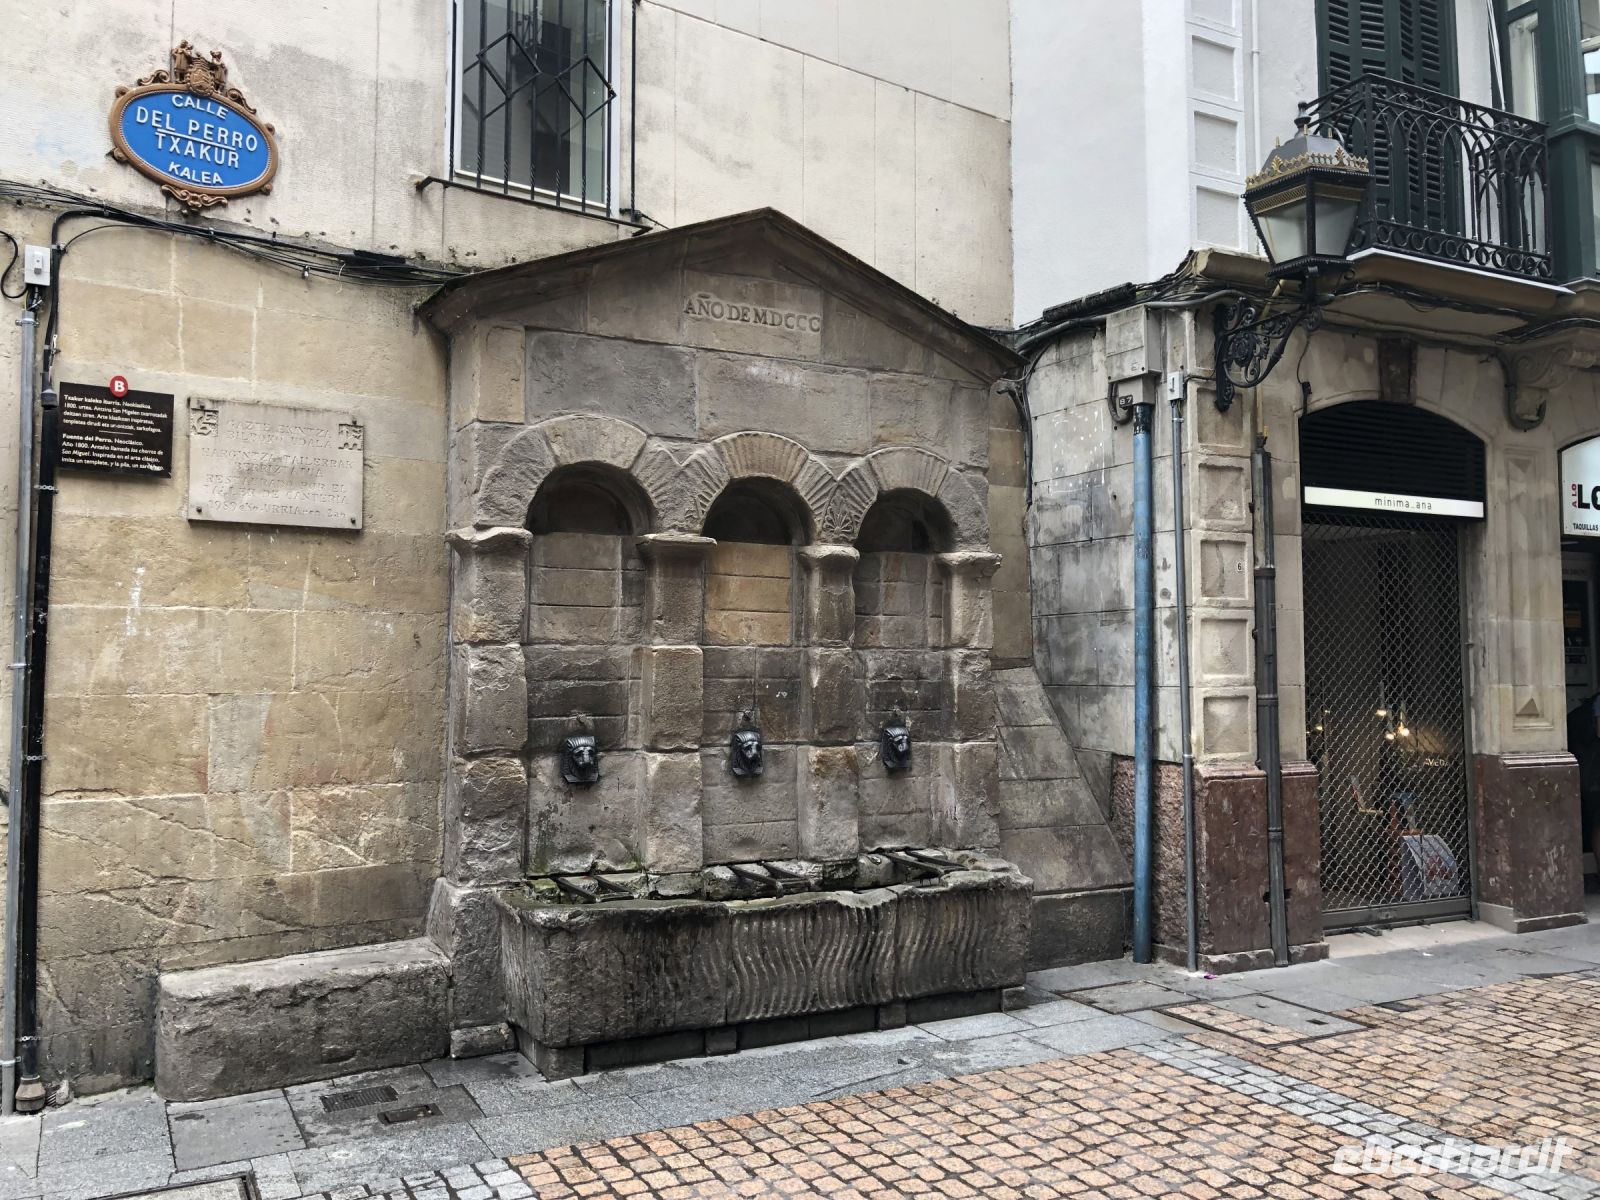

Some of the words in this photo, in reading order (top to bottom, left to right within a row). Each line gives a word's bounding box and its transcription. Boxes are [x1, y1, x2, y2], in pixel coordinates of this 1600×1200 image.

[171, 94, 229, 120] CALLE
[136, 106, 176, 131] DEL
[188, 119, 258, 152] PERRO
[155, 131, 239, 169] TXAKUR
[168, 161, 223, 185] KALEA
[684, 293, 724, 319] AÑO
[114, 380, 125, 392] B
[63, 433, 84, 441] Fuente
[1573, 523, 1599, 531] TAQUILLAS
